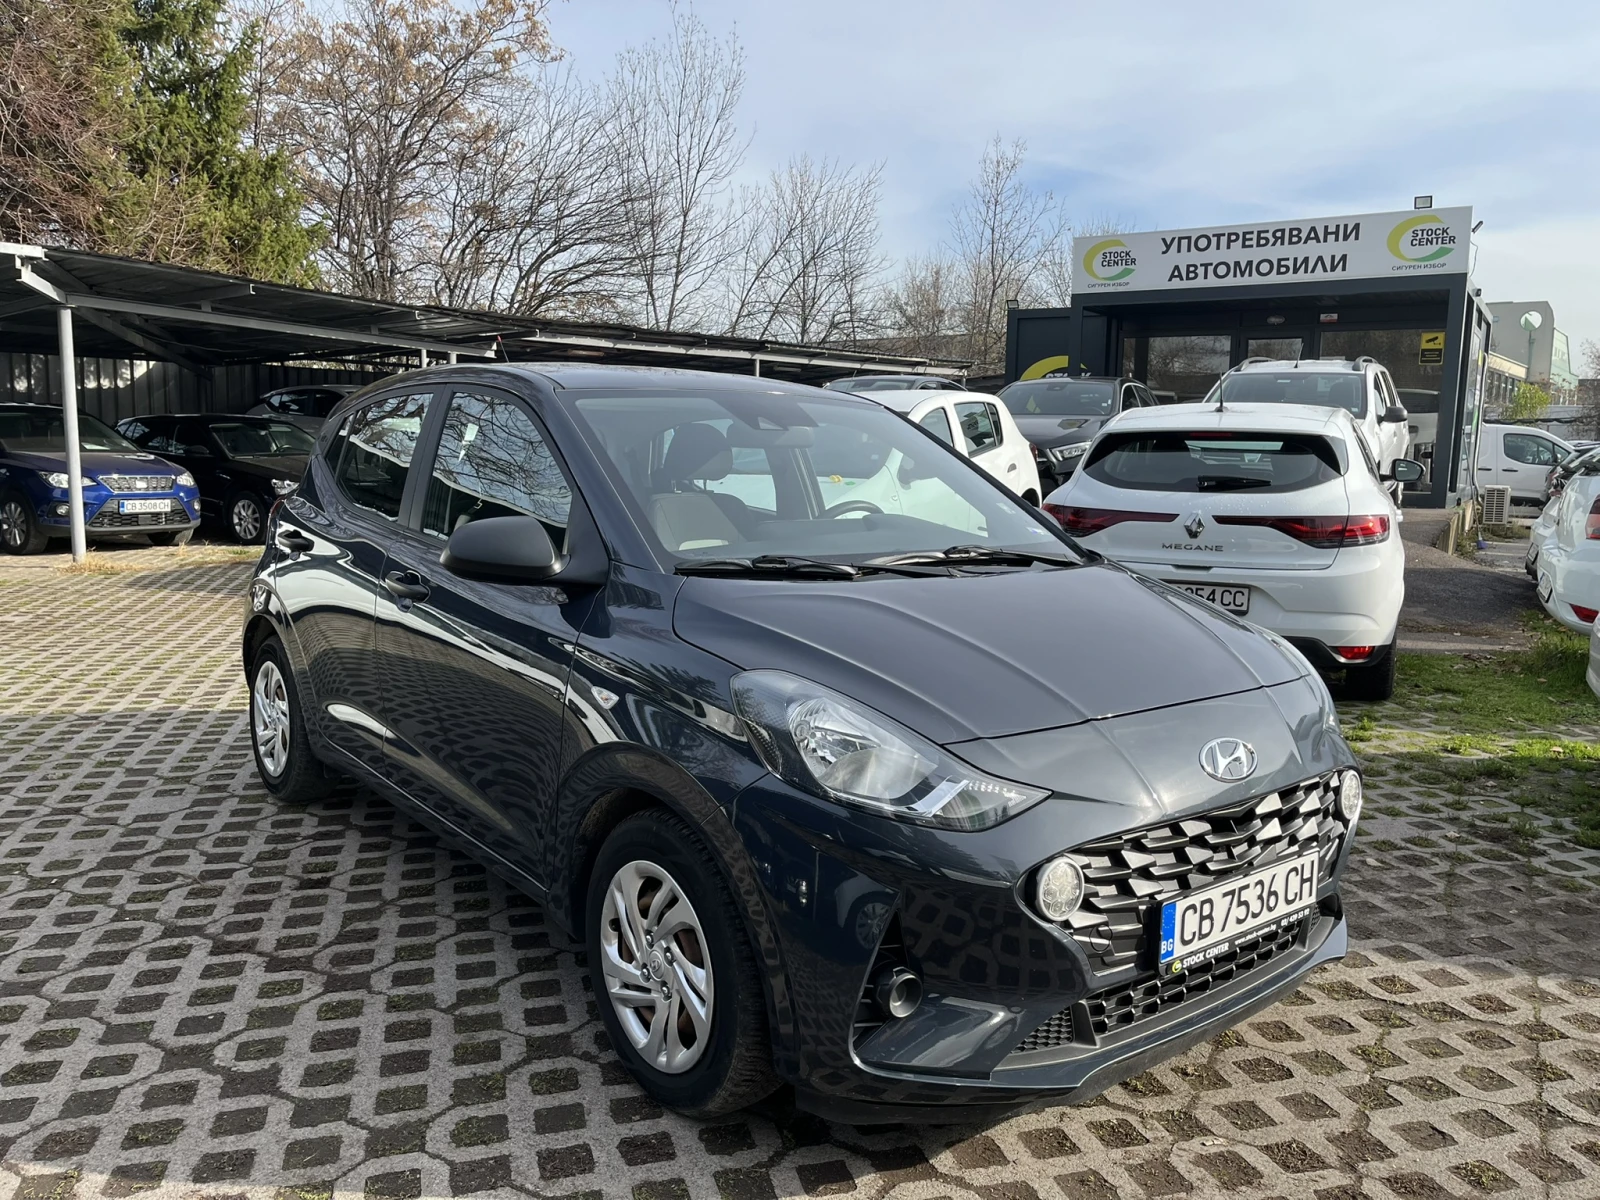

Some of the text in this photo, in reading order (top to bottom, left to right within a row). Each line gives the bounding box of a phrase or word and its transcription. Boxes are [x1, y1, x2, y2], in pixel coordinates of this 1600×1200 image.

[1161, 222, 1361, 255] УПОТРЕБЯВАНИ
[1411, 226, 1450, 238] STOCK
[1410, 235, 1456, 247] CENTER
[1101, 249, 1132, 260] STOCK
[1101, 257, 1137, 268] CENTER
[1167, 253, 1348, 282] АВТОМОБИЛИ
[1423, 262, 1447, 270] ИЗБОР
[1161, 542, 1224, 552] MEGANE
[1220, 589, 1245, 608] CC
[1180, 860, 1315, 947] CB 7536 CH
[1161, 938, 1174, 955] BG
[1182, 942, 1230, 968] STOCK CENTER
